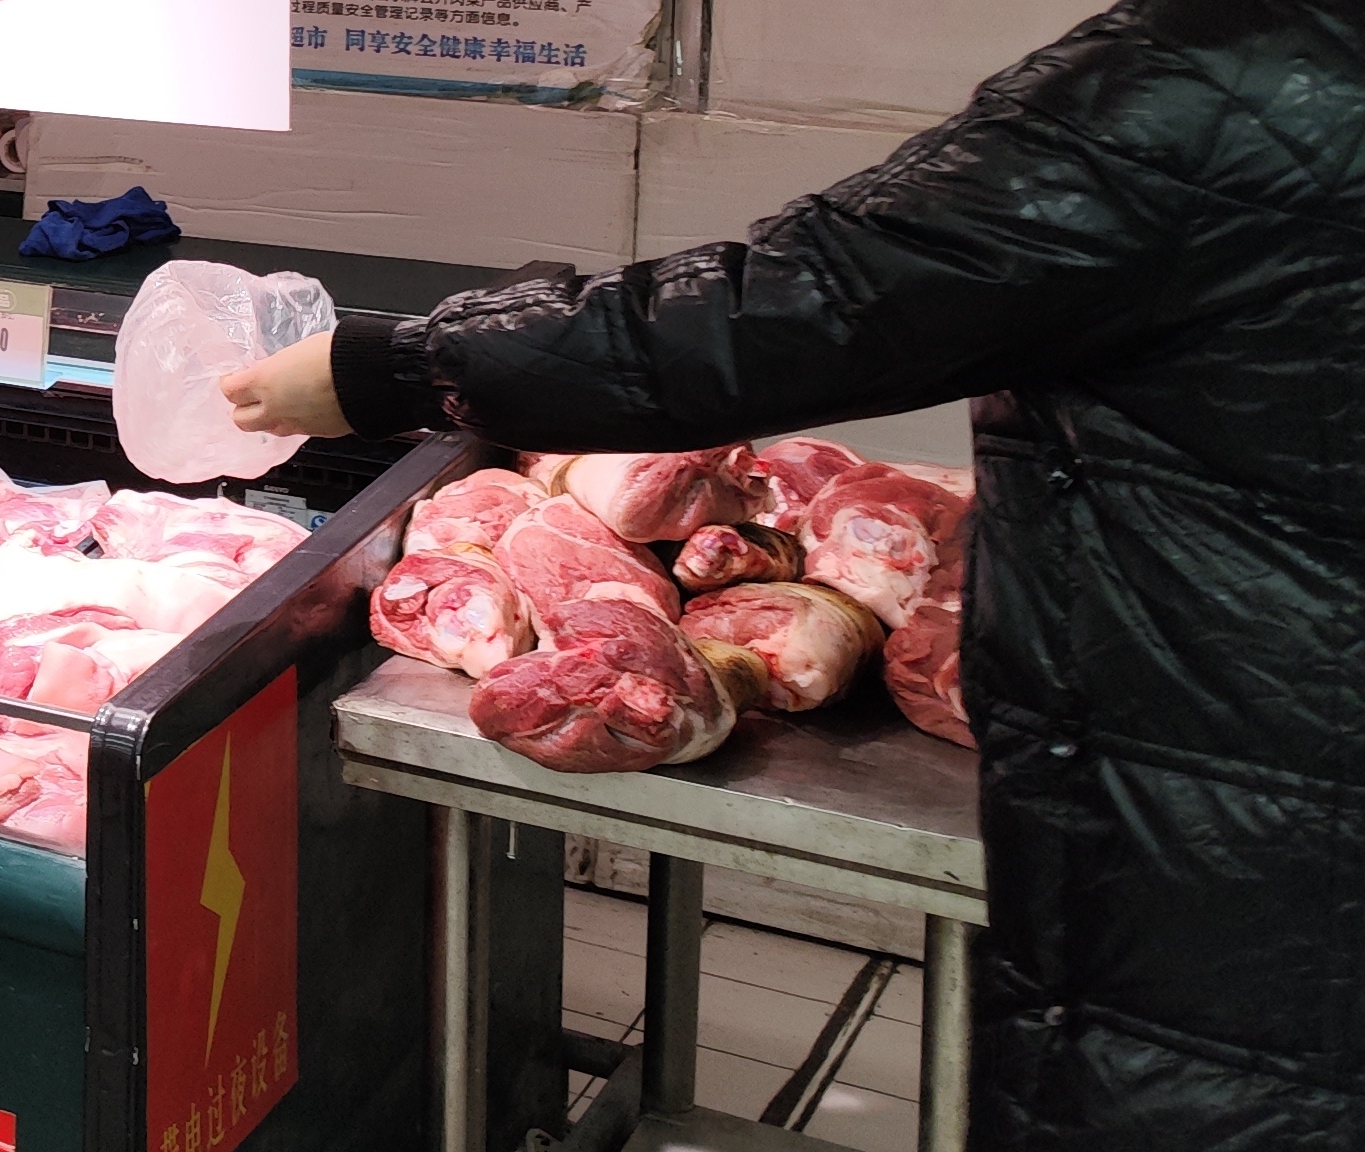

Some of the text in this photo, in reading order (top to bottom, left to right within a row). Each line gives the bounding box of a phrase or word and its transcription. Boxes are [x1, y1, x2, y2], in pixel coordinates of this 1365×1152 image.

[344, 28, 588, 68] 同享安全健康幸福生活
